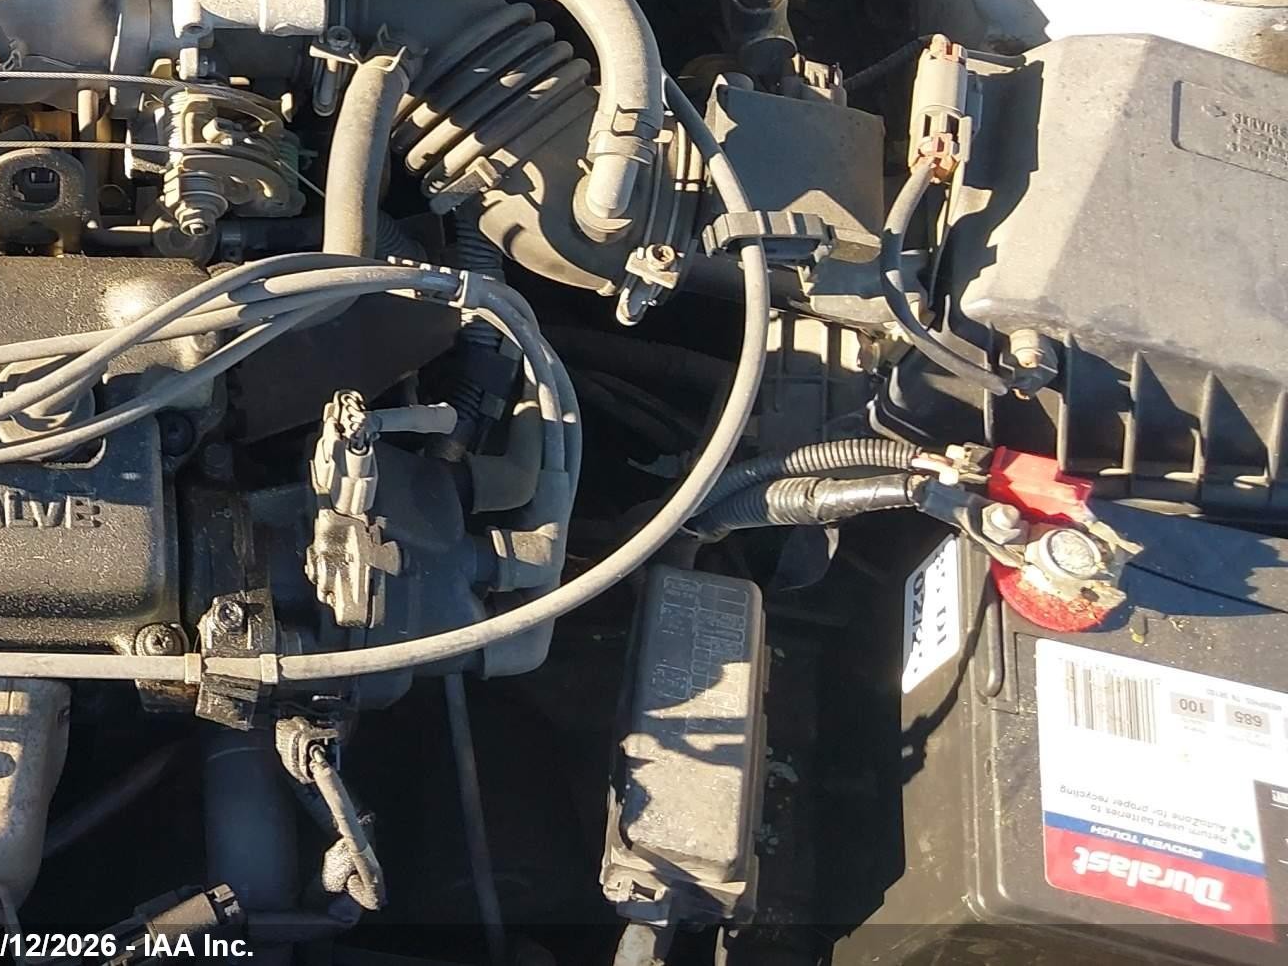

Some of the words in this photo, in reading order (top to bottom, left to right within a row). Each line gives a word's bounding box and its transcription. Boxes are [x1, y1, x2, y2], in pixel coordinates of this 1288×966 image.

[1179, 698, 1207, 715] 100
[1233, 710, 1263, 728] 685
[1090, 825, 1139, 844] TOUGH
[1142, 837, 1204, 859] PROVEN
[1073, 846, 1232, 912] Duralast
